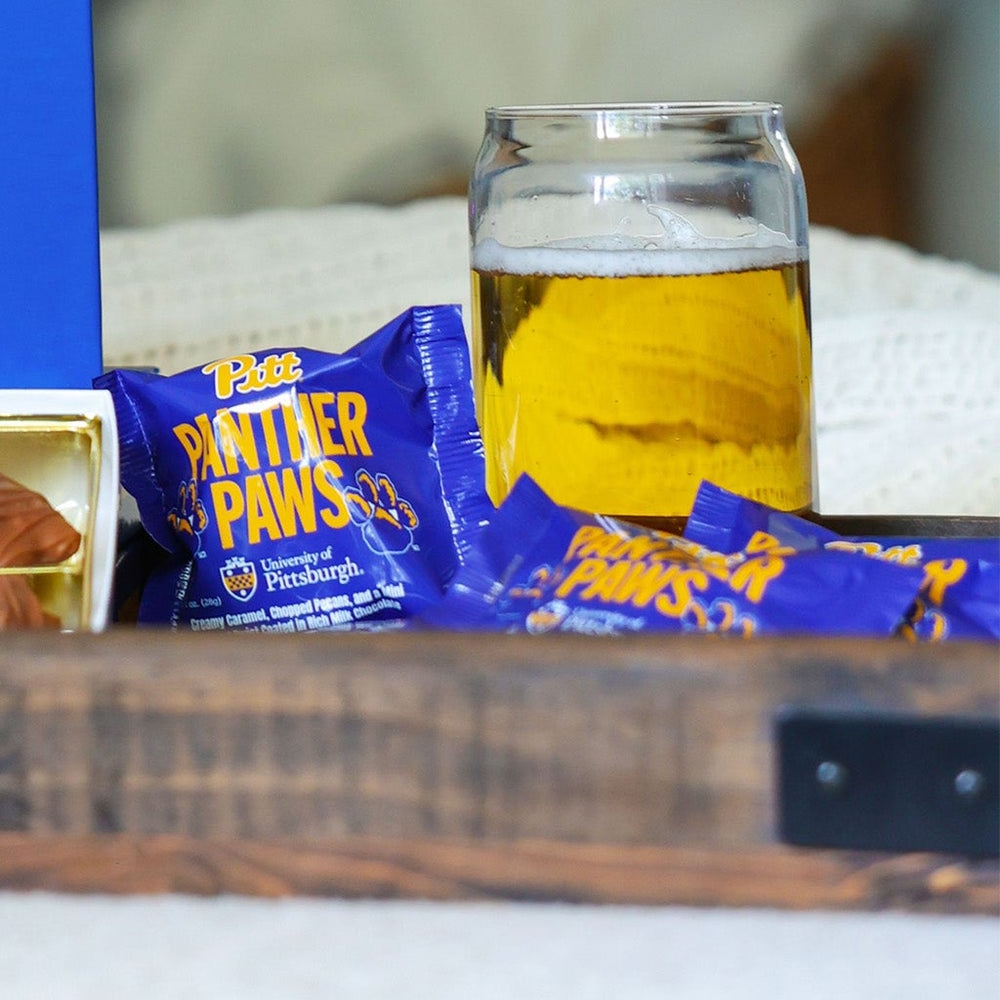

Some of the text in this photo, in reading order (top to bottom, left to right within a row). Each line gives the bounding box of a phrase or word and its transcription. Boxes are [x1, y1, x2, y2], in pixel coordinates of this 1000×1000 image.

[202, 351, 303, 400] Pitt
[172, 391, 373, 481] PANTHER
[210, 460, 350, 550] PAWS
[261, 545, 333, 572] University of
[190, 617, 225, 632] Creamy
[226, 608, 270, 627] Caramel,
[269, 600, 314, 620] Chopped
[313, 594, 354, 613] Pecans,
[353, 589, 373, 605] and
[555, 557, 708, 618] PAWS
[306, 614, 331, 630] Rich
[353, 599, 402, 619] Chocolate
